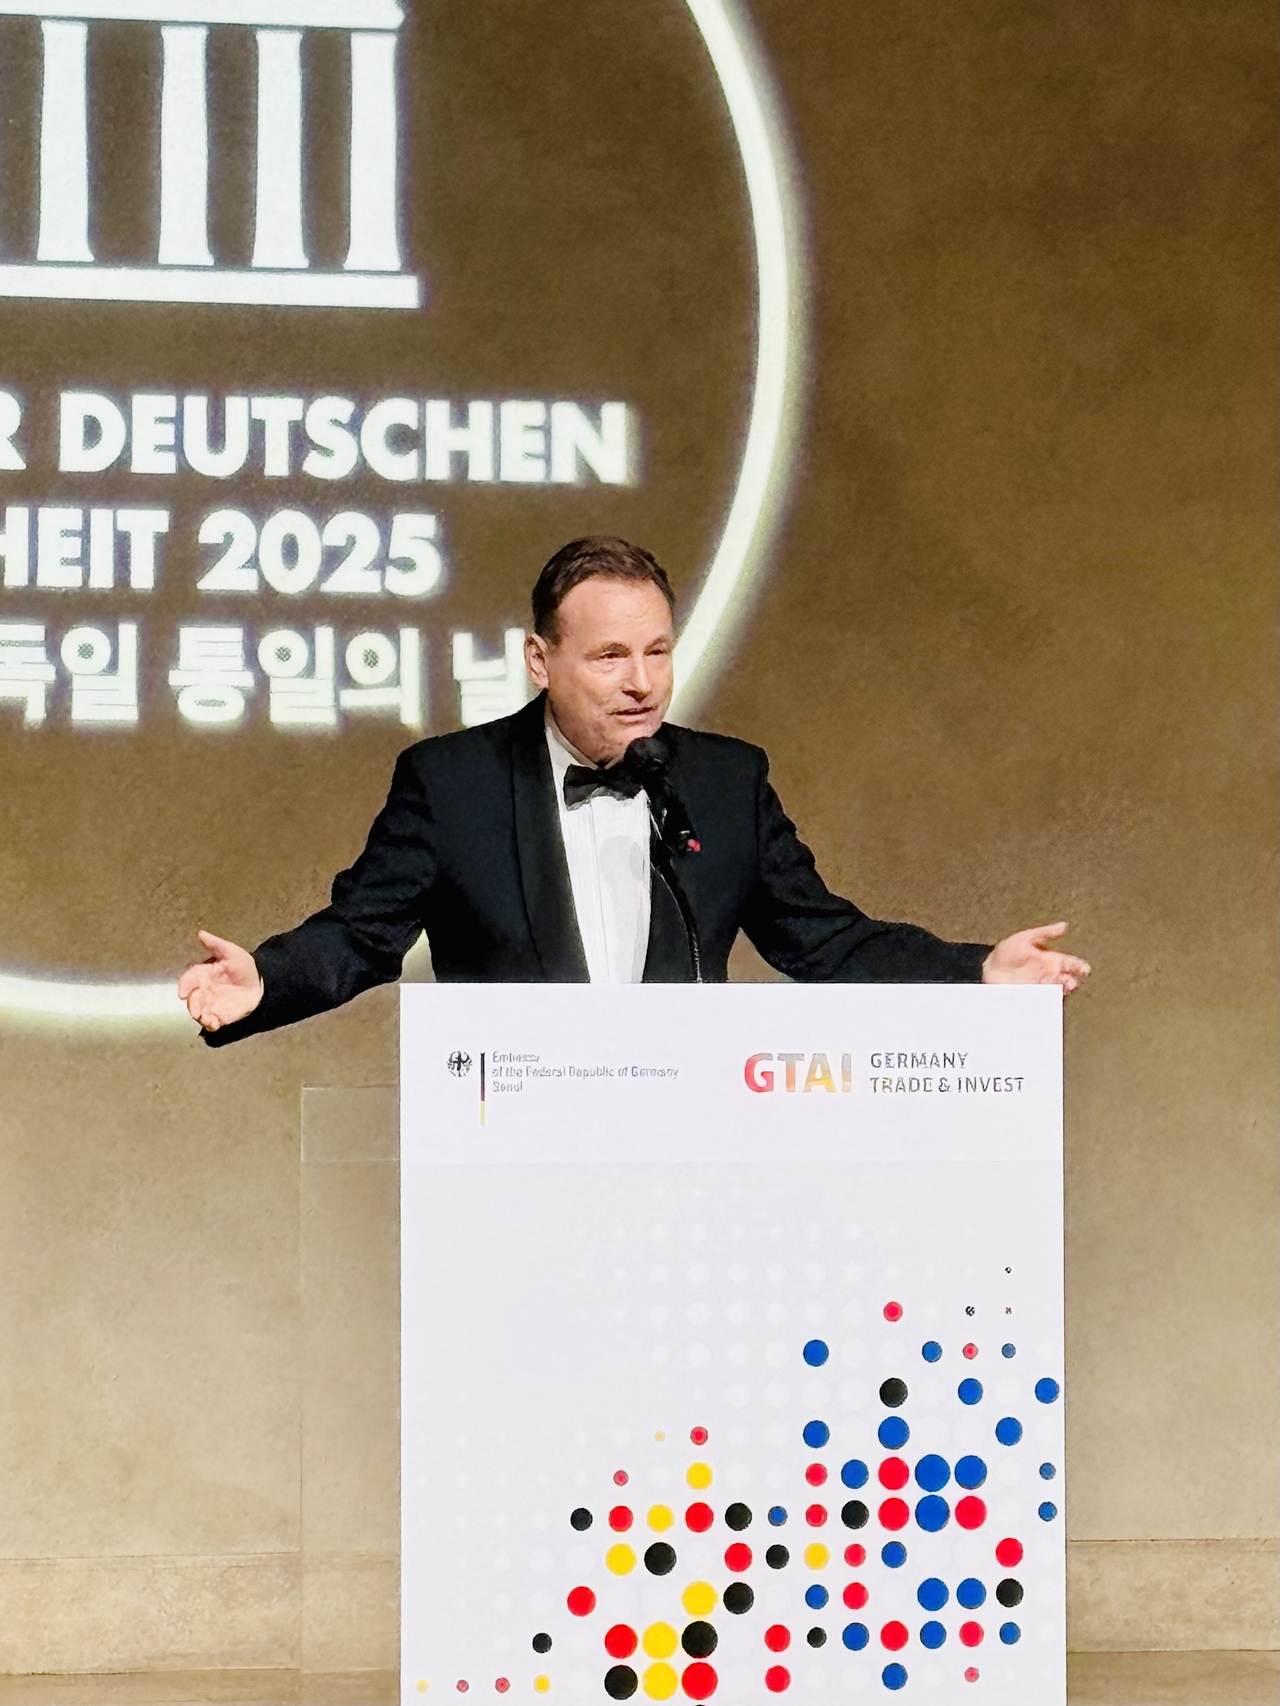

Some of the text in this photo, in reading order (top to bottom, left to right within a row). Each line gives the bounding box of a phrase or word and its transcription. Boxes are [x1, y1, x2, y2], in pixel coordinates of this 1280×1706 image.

[60, 391, 628, 484] DEUTSCHEN
[197, 509, 442, 595] 2025
[168, 626, 421, 727] 통일의
[744, 1052, 853, 1094] GTAI
[870, 1052, 968, 1069] GERMANY
[870, 1076, 1024, 1094] TRADE & INVEST
